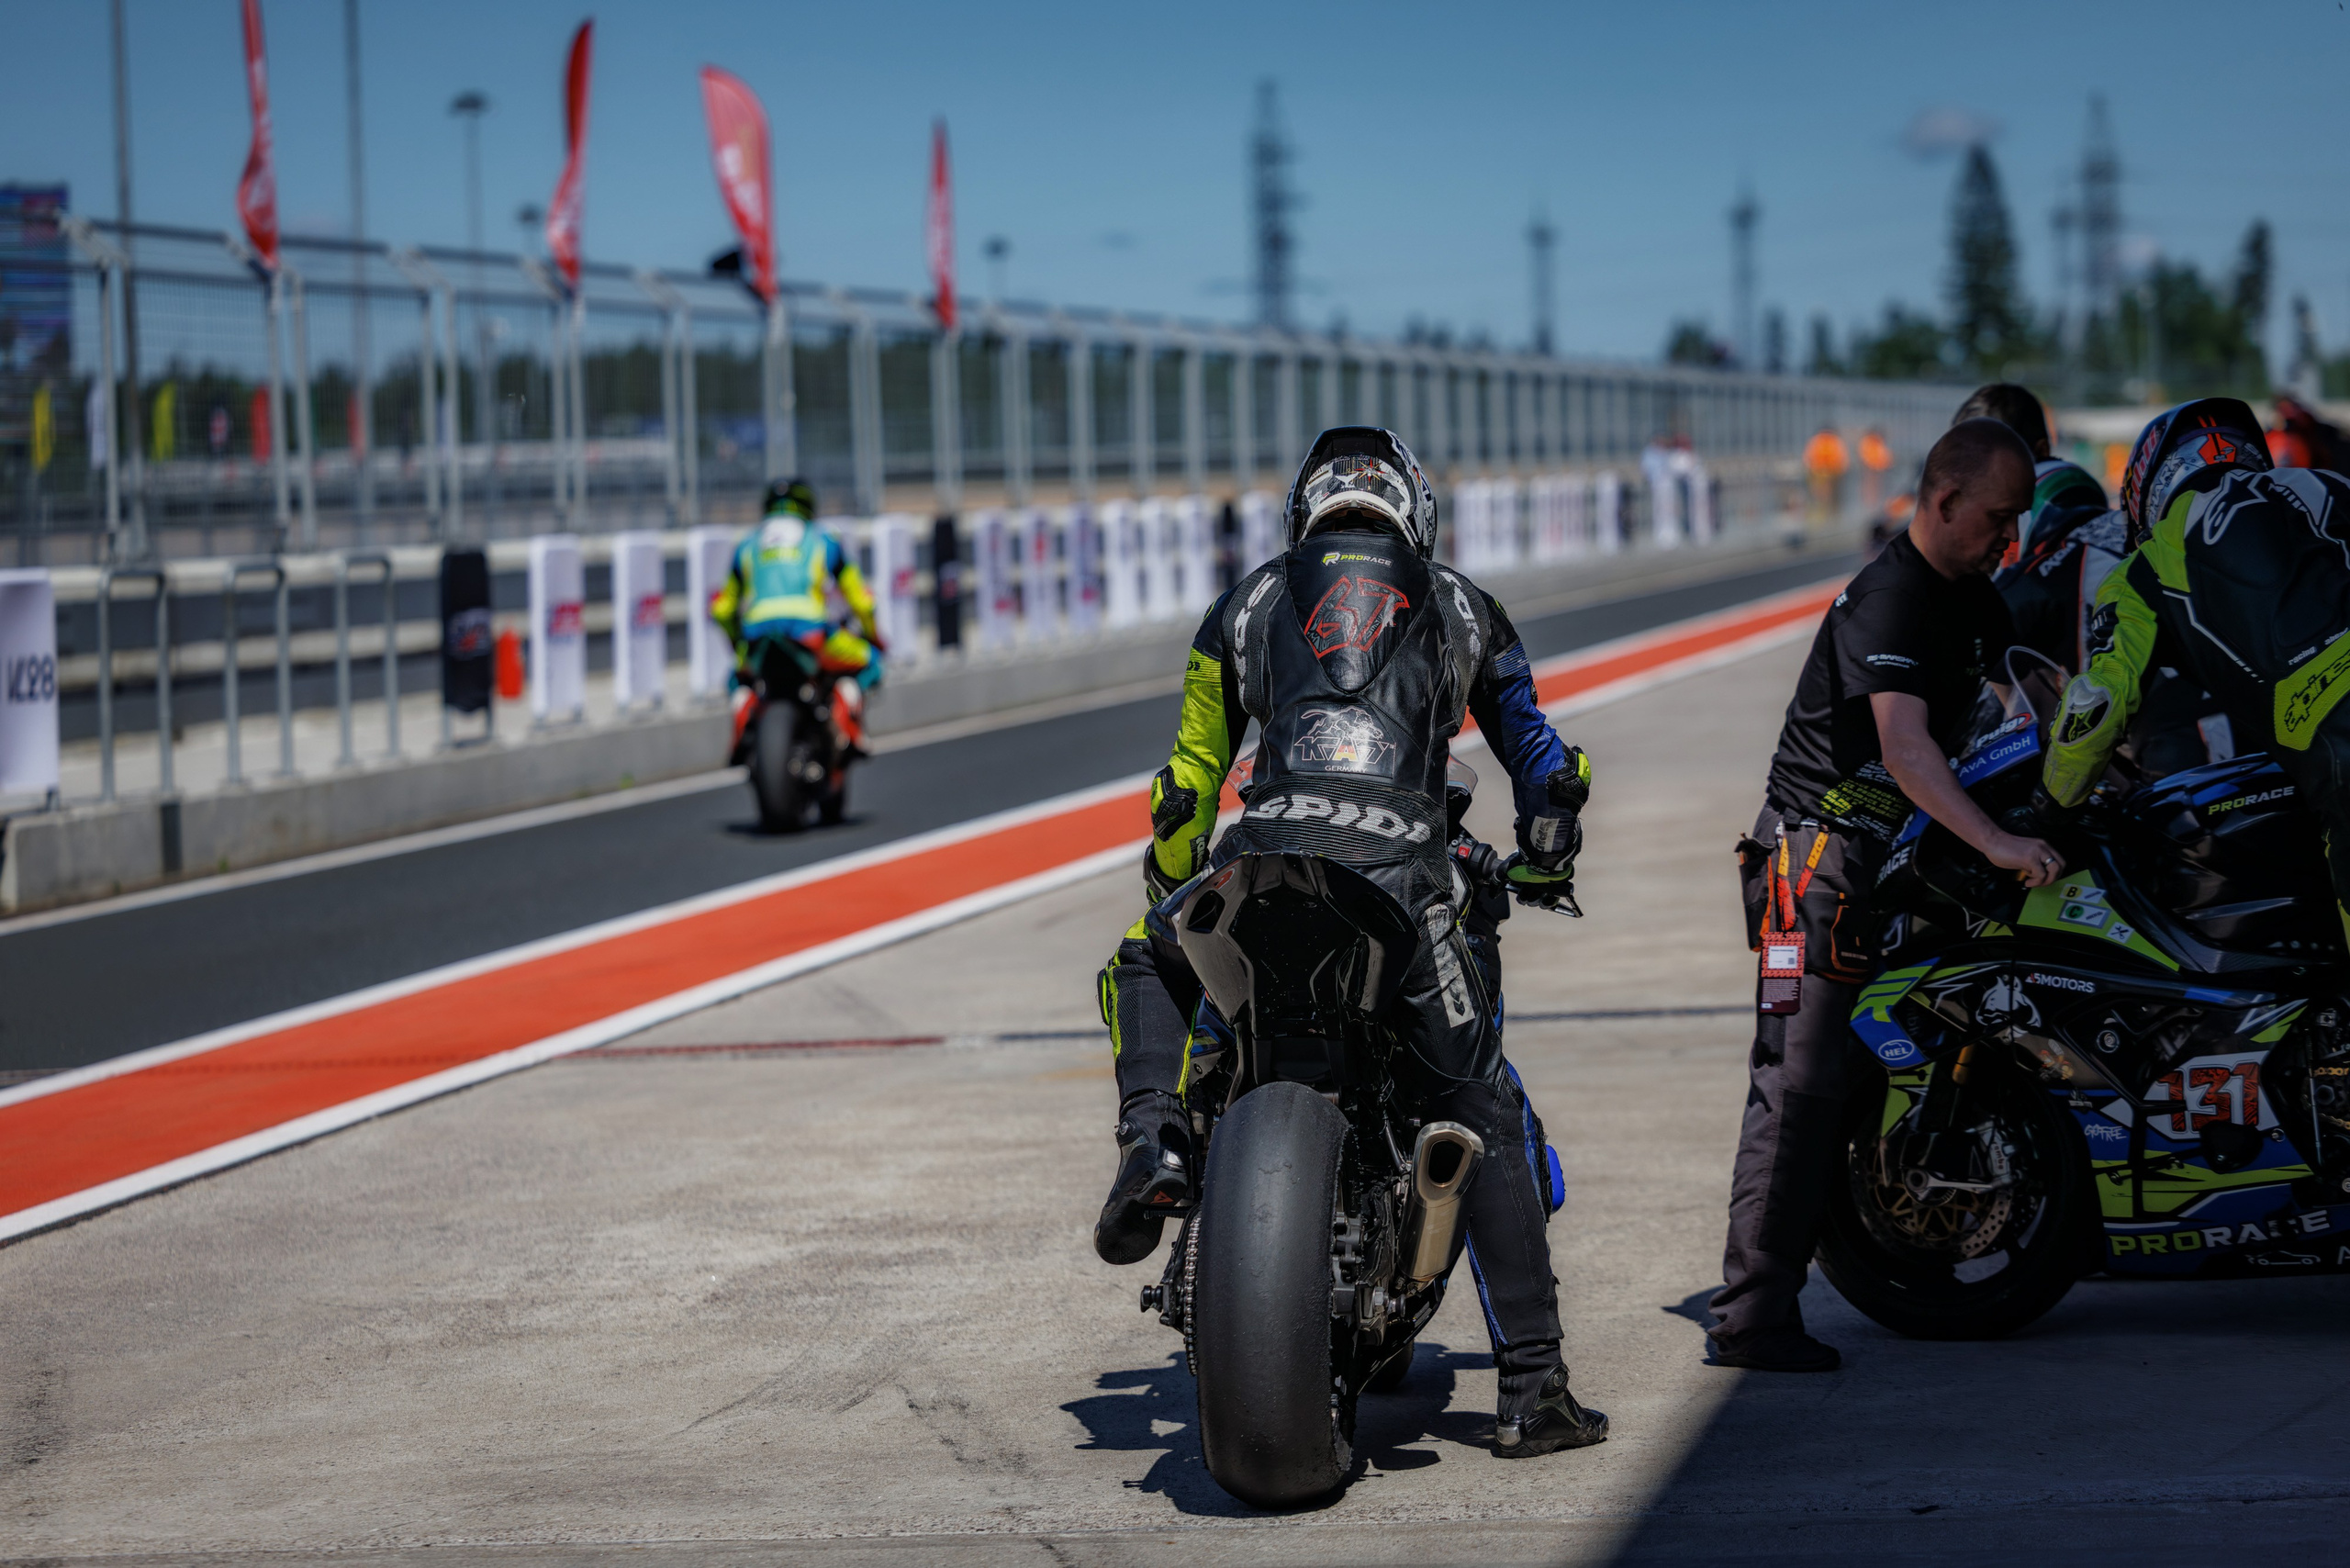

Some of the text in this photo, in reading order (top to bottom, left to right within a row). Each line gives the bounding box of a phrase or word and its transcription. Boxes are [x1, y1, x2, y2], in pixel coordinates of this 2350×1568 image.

[1340, 554, 1392, 566] PRORACE
[1304, 576, 1410, 659] 67
[2288, 645, 2317, 666] racing
[1959, 735, 2031, 778] AvA GmbH
[1325, 765, 1368, 774] GERMANY
[2208, 786, 2296, 815] PRORACE
[1244, 793, 1431, 846] SPIDI
[2066, 887, 2078, 898] B
[2067, 906, 2081, 918] C
[1885, 1047, 1909, 1058] HEL
[2156, 1062, 2260, 1133] 131
